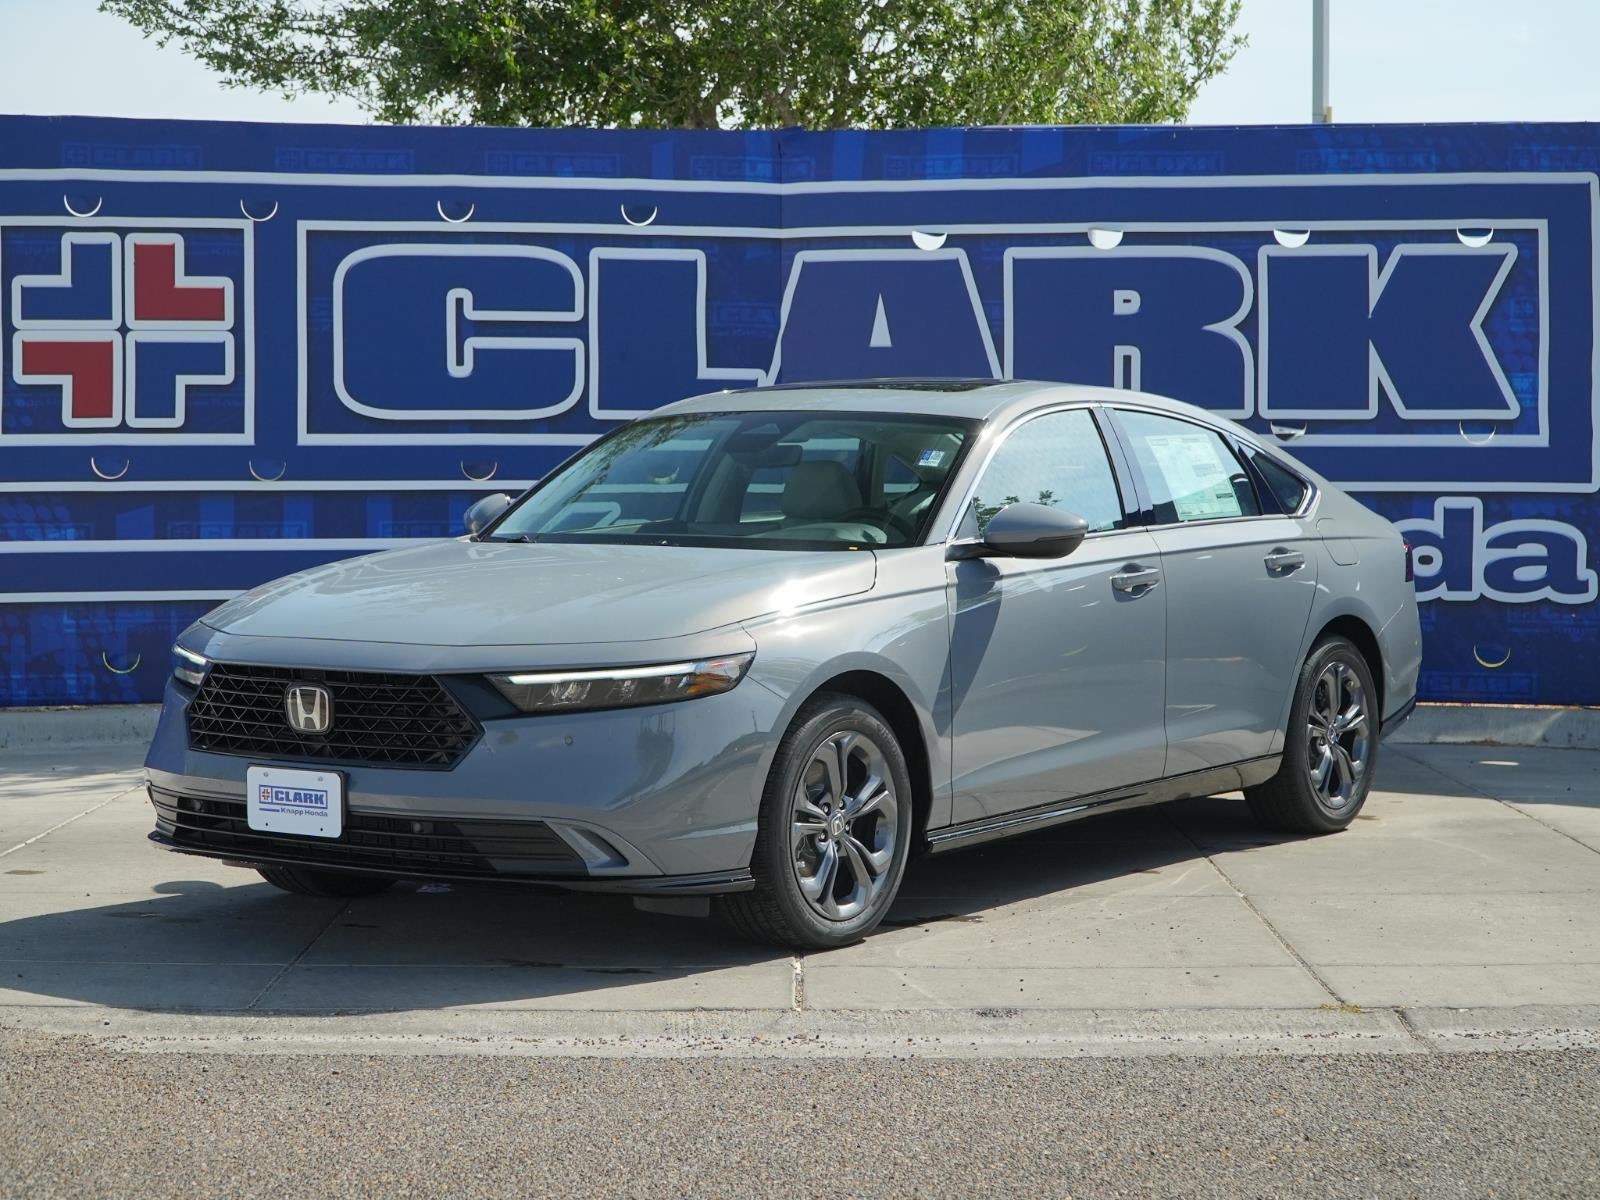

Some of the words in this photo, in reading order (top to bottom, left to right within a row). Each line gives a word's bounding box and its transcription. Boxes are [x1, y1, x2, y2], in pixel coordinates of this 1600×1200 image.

[333, 243, 1521, 422] CLARK
[1396, 496, 1599, 605] da
[274, 790, 325, 805] CLARK
[280, 807, 304, 815] Knapp
